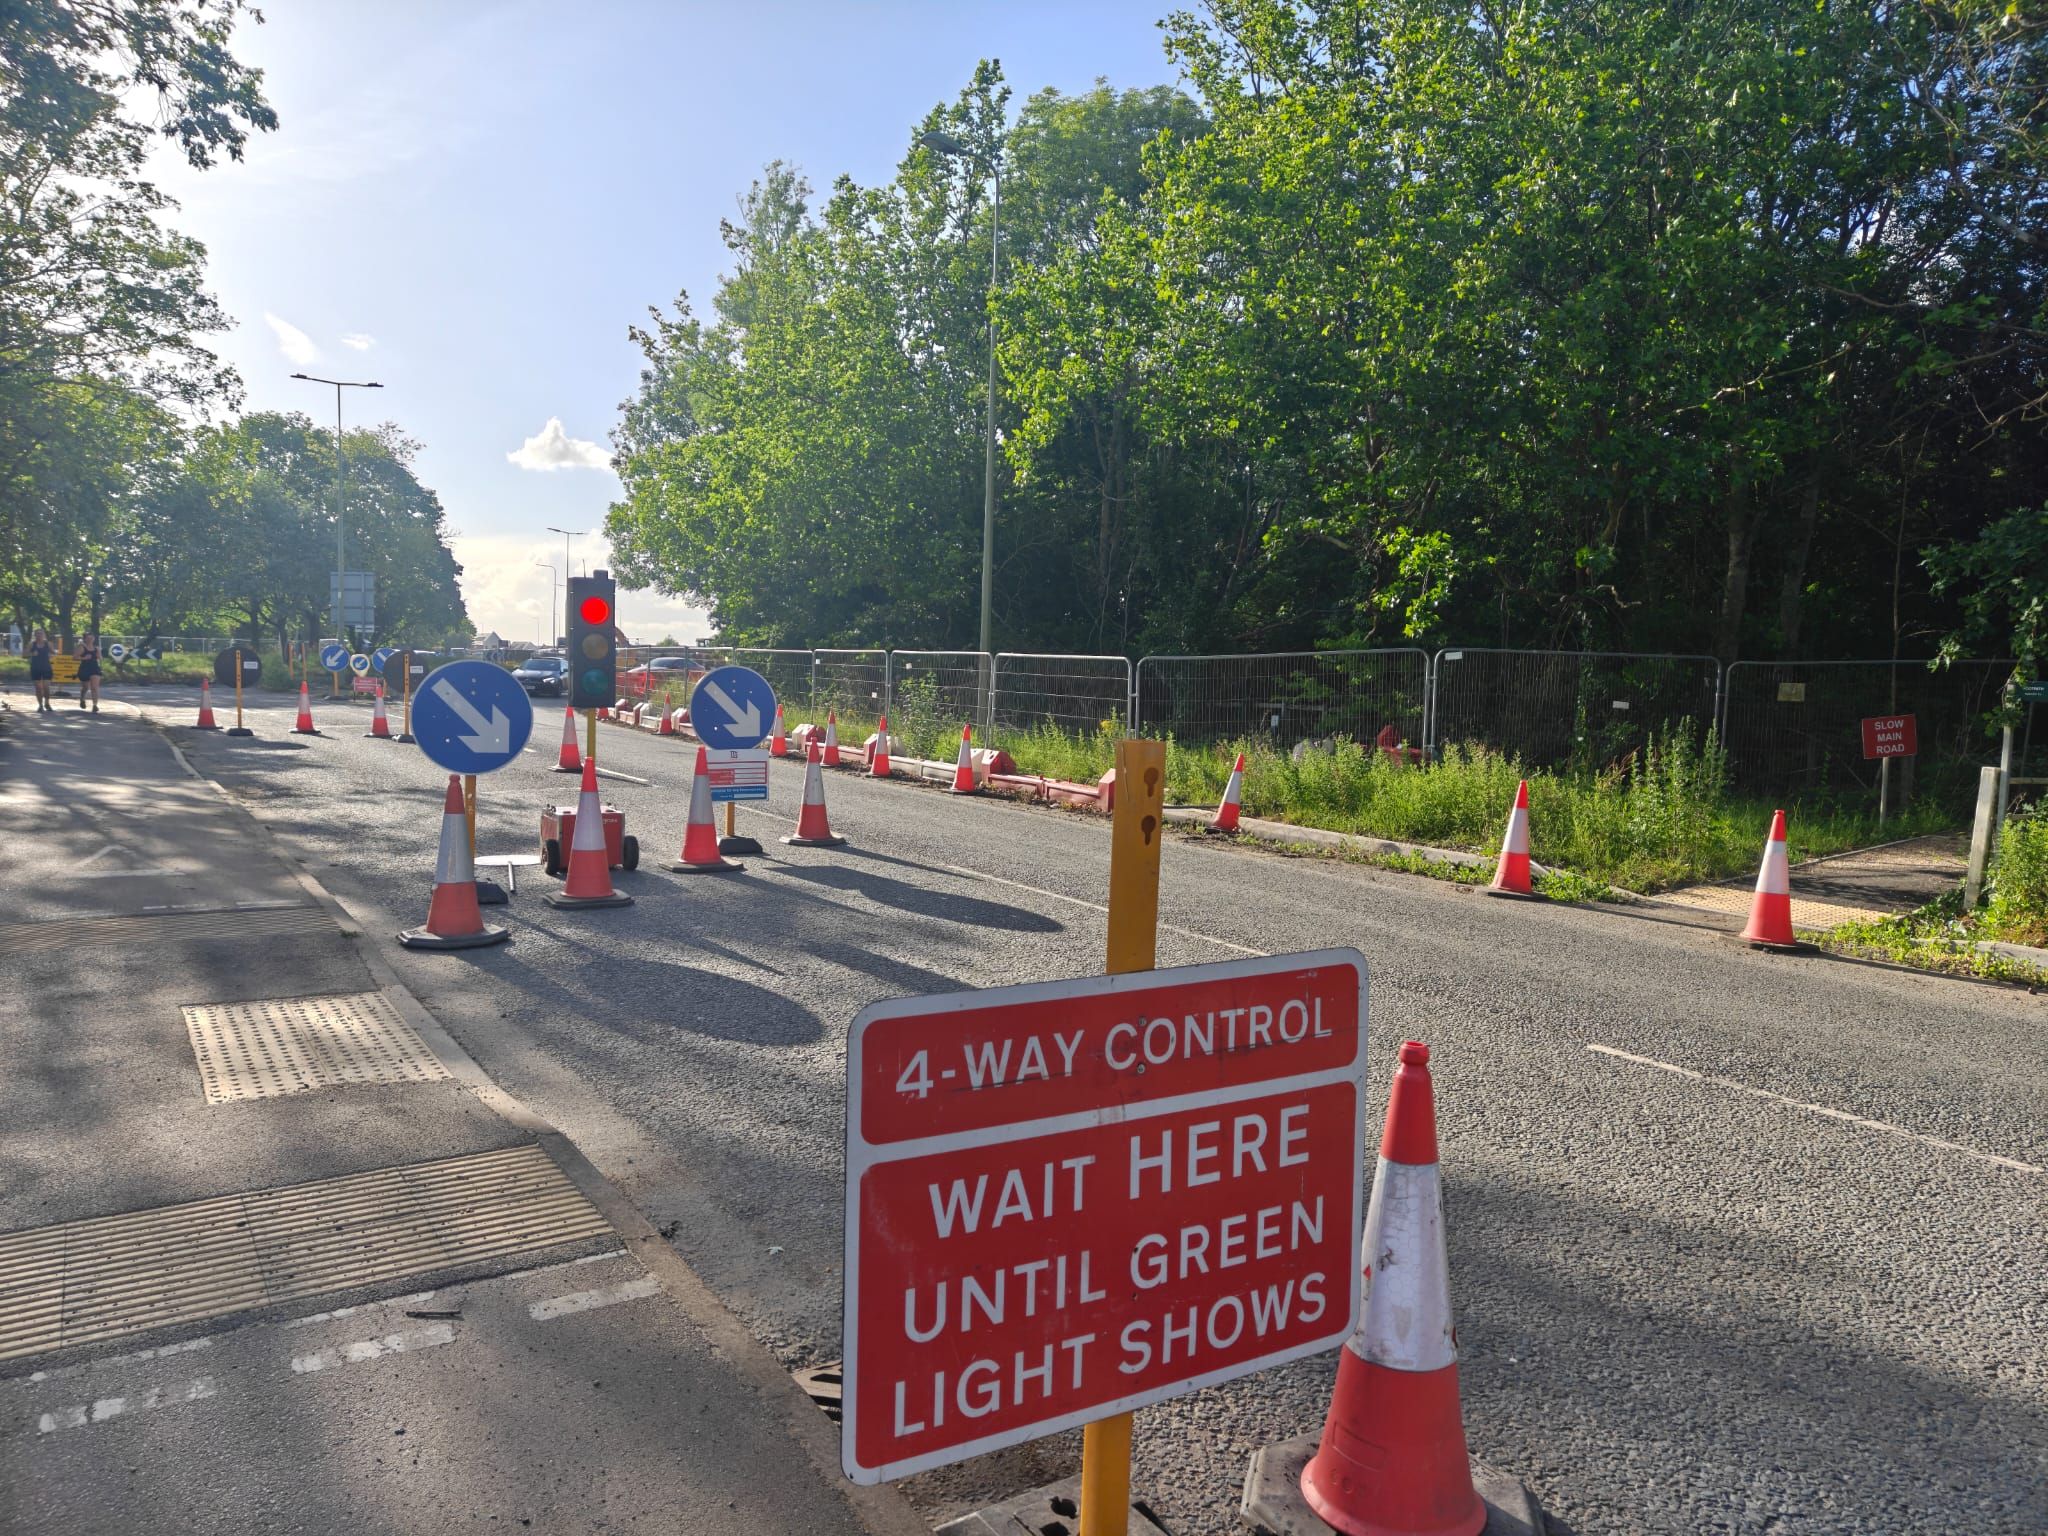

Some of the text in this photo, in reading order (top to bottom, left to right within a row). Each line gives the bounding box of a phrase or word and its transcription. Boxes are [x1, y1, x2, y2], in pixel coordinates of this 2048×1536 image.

[1874, 719, 1904, 730] SLOW
[1876, 743, 1905, 754] ROAD
[1877, 731, 1902, 742] MAIN
[895, 997, 1332, 1098] 4-WAY CONTROL
[929, 1104, 1309, 1238] WAIT HERE
[905, 1196, 1324, 1343] UNTIL GREEN
[894, 1272, 1326, 1437] LIGHT SHOWS
